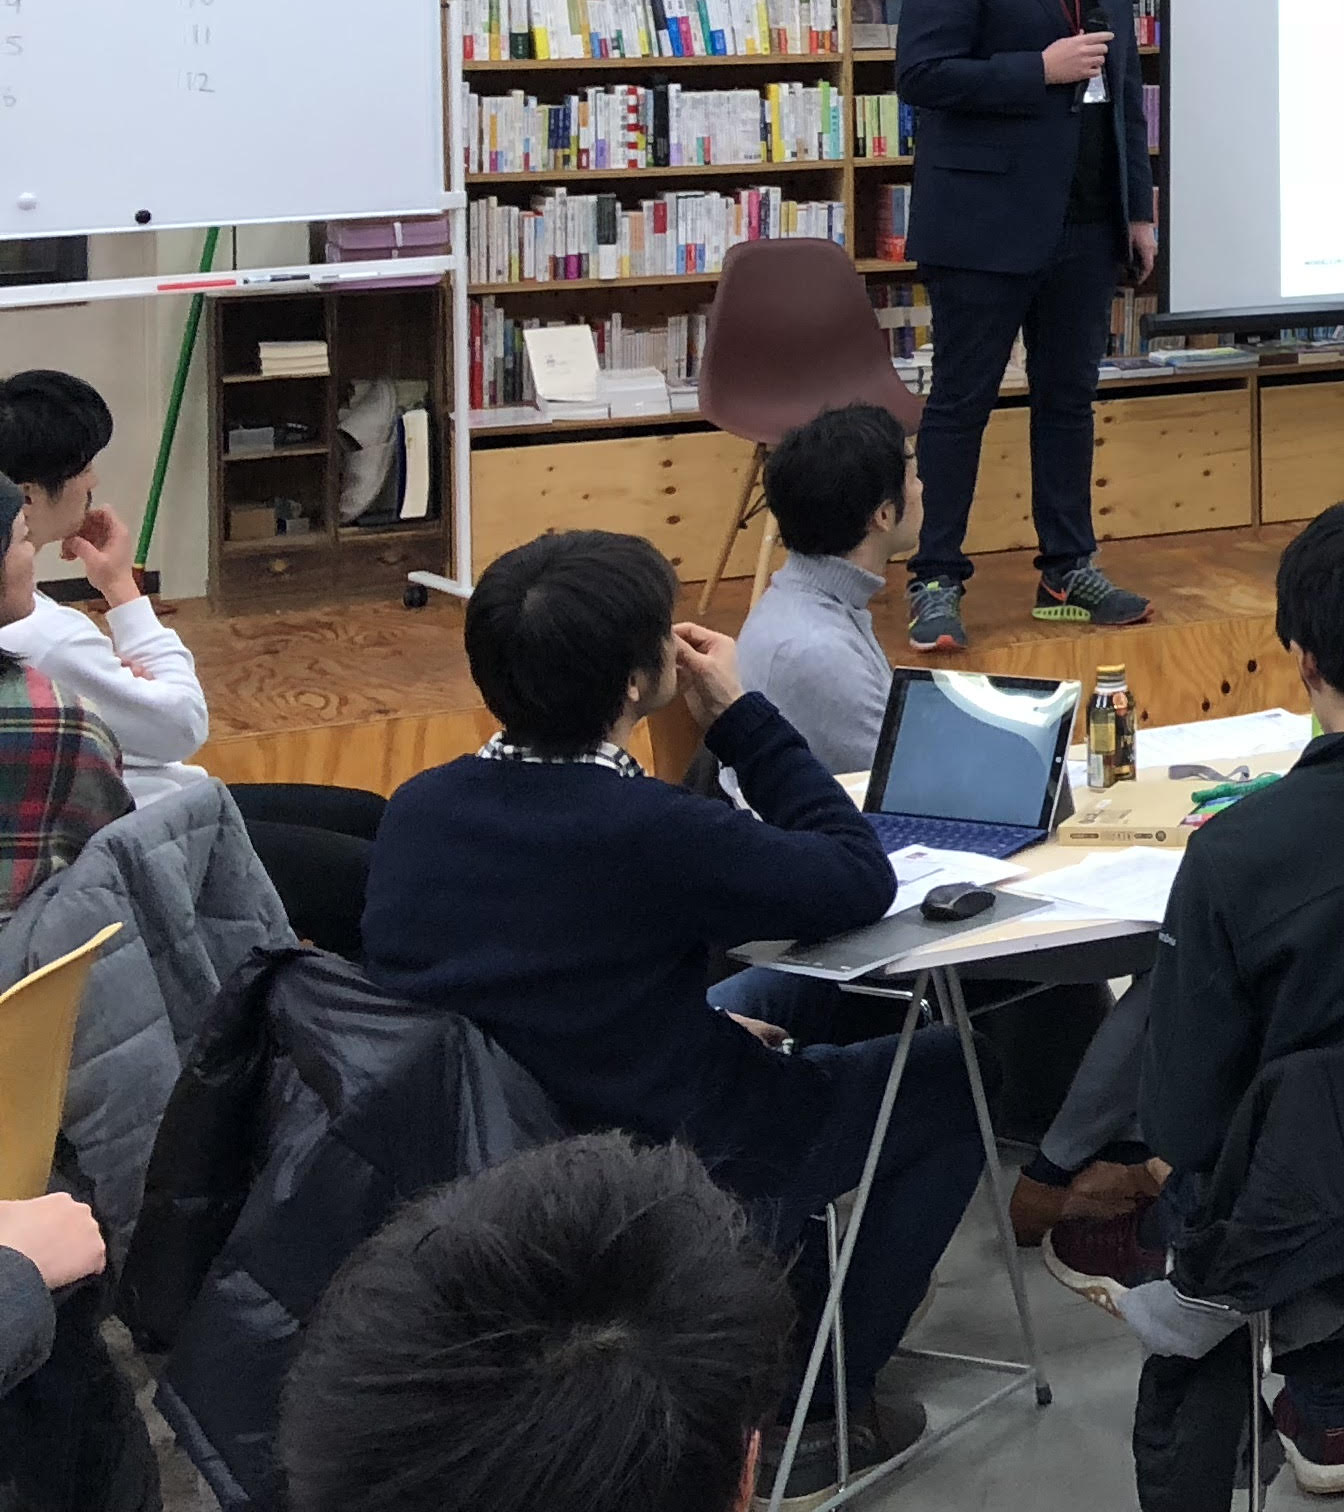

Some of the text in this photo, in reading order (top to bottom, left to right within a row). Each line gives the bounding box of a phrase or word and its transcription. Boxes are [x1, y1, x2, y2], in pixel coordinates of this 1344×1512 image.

[3, 34, 25, 56] 5
[191, 23, 212, 46] 11
[186, 71, 216, 94] 12
